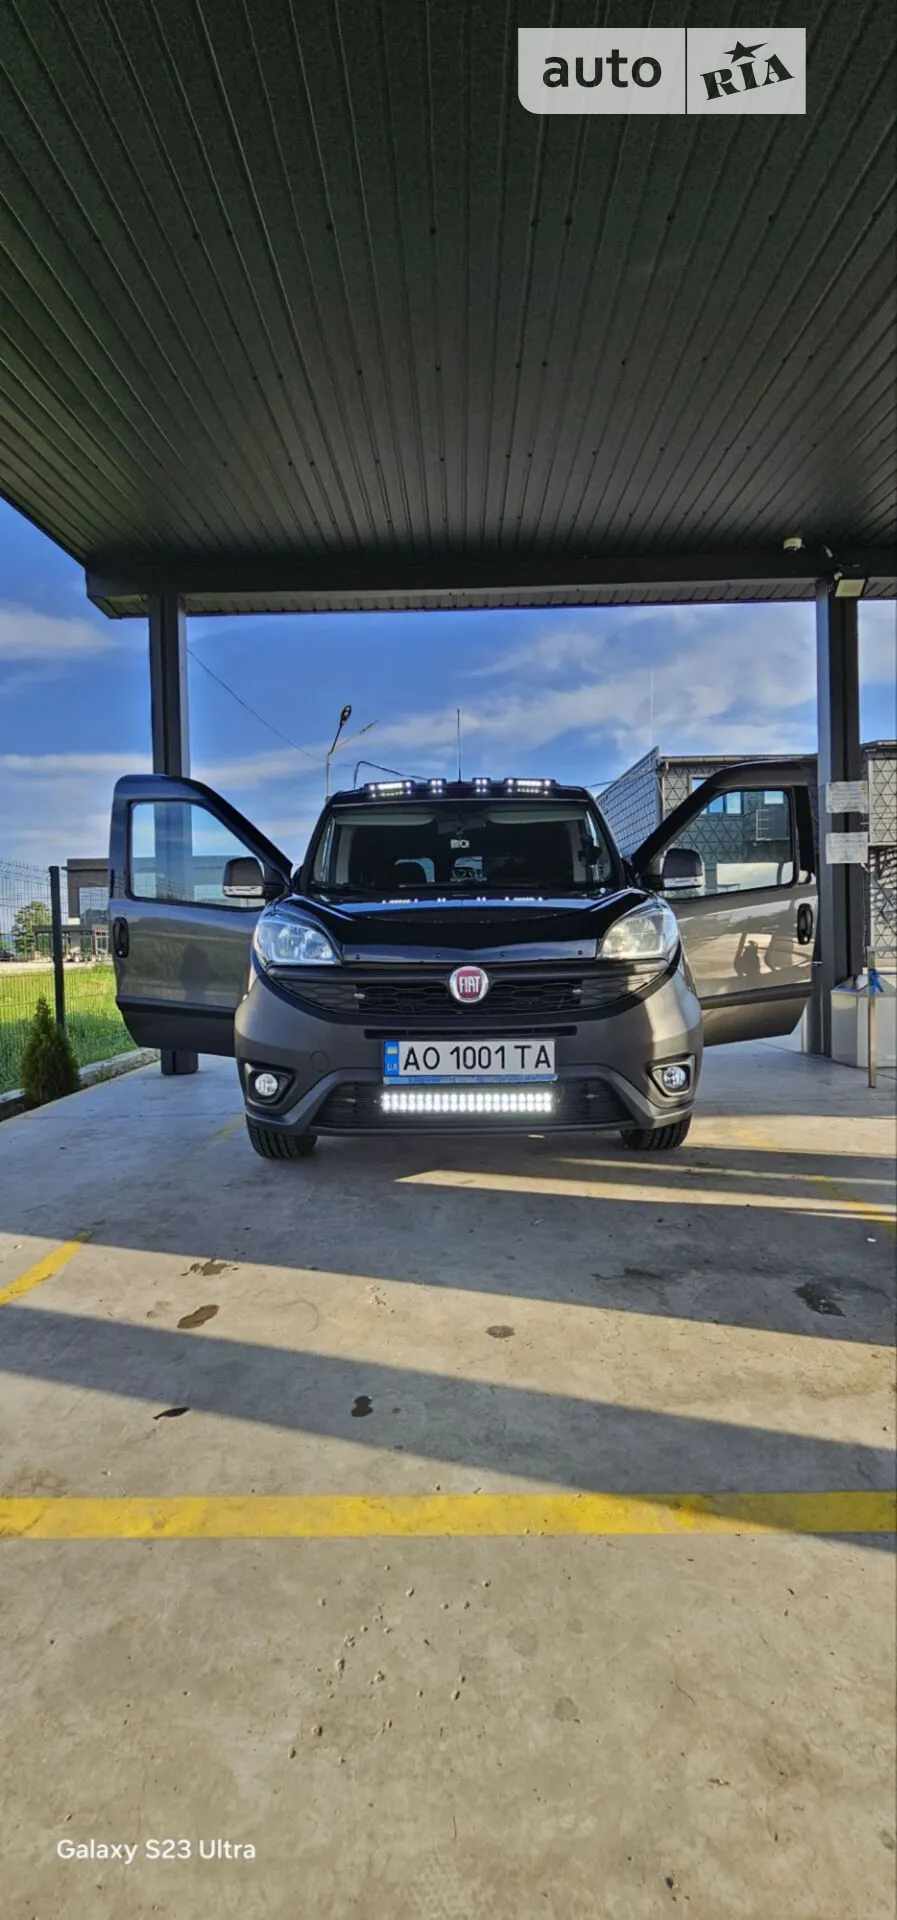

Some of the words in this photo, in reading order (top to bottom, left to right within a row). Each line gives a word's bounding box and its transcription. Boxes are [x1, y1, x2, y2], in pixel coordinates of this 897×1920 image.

[459, 975, 481, 993] FIAT
[387, 1063, 398, 1071] UA
[403, 1046, 441, 1071] AO
[449, 1045, 506, 1070] 1001
[514, 1045, 552, 1069] TA
